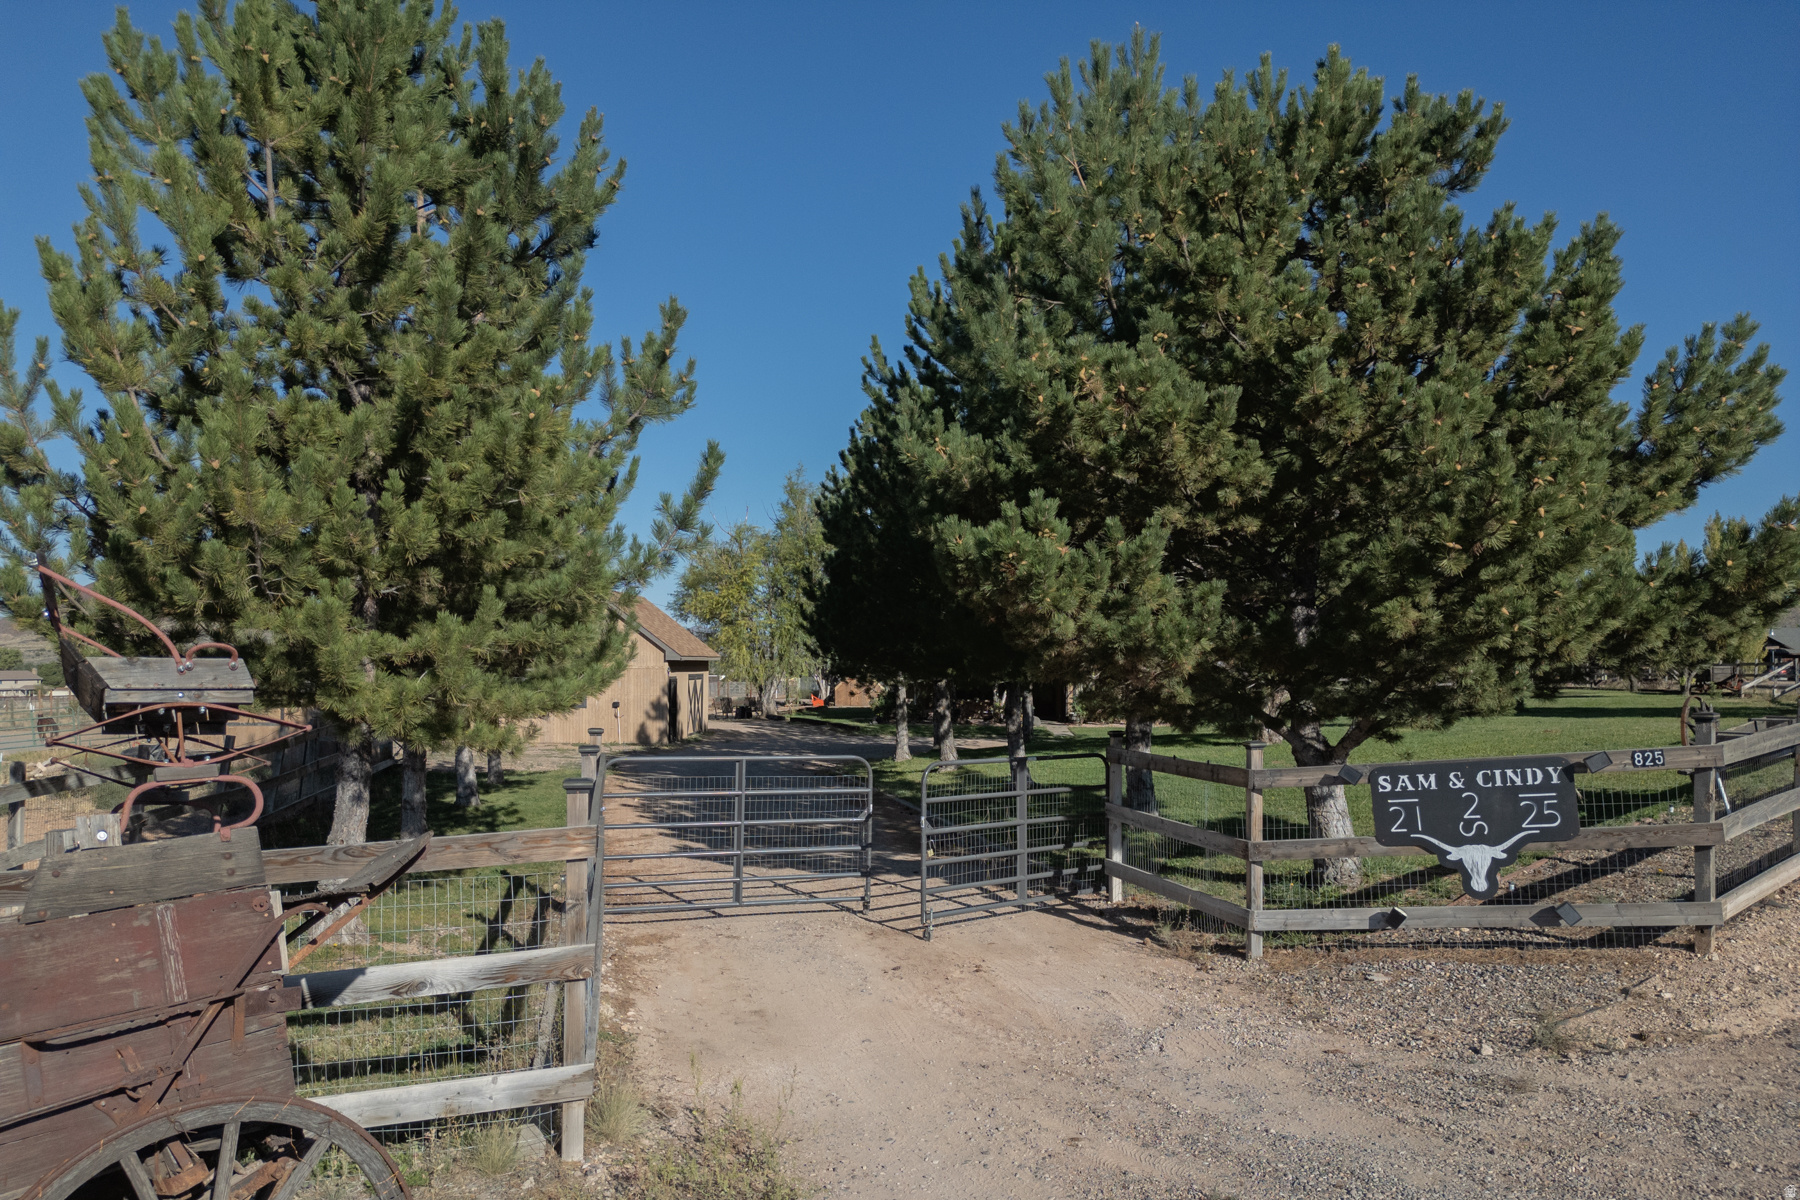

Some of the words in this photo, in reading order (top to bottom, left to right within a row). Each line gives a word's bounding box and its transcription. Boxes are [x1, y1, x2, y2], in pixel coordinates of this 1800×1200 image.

[1633, 750, 1665, 767] 825
[1377, 773, 1438, 792] SAM
[1448, 771, 1466, 789] &
[1475, 766, 1563, 788] CINDY
[1519, 799, 1561, 828] 25
